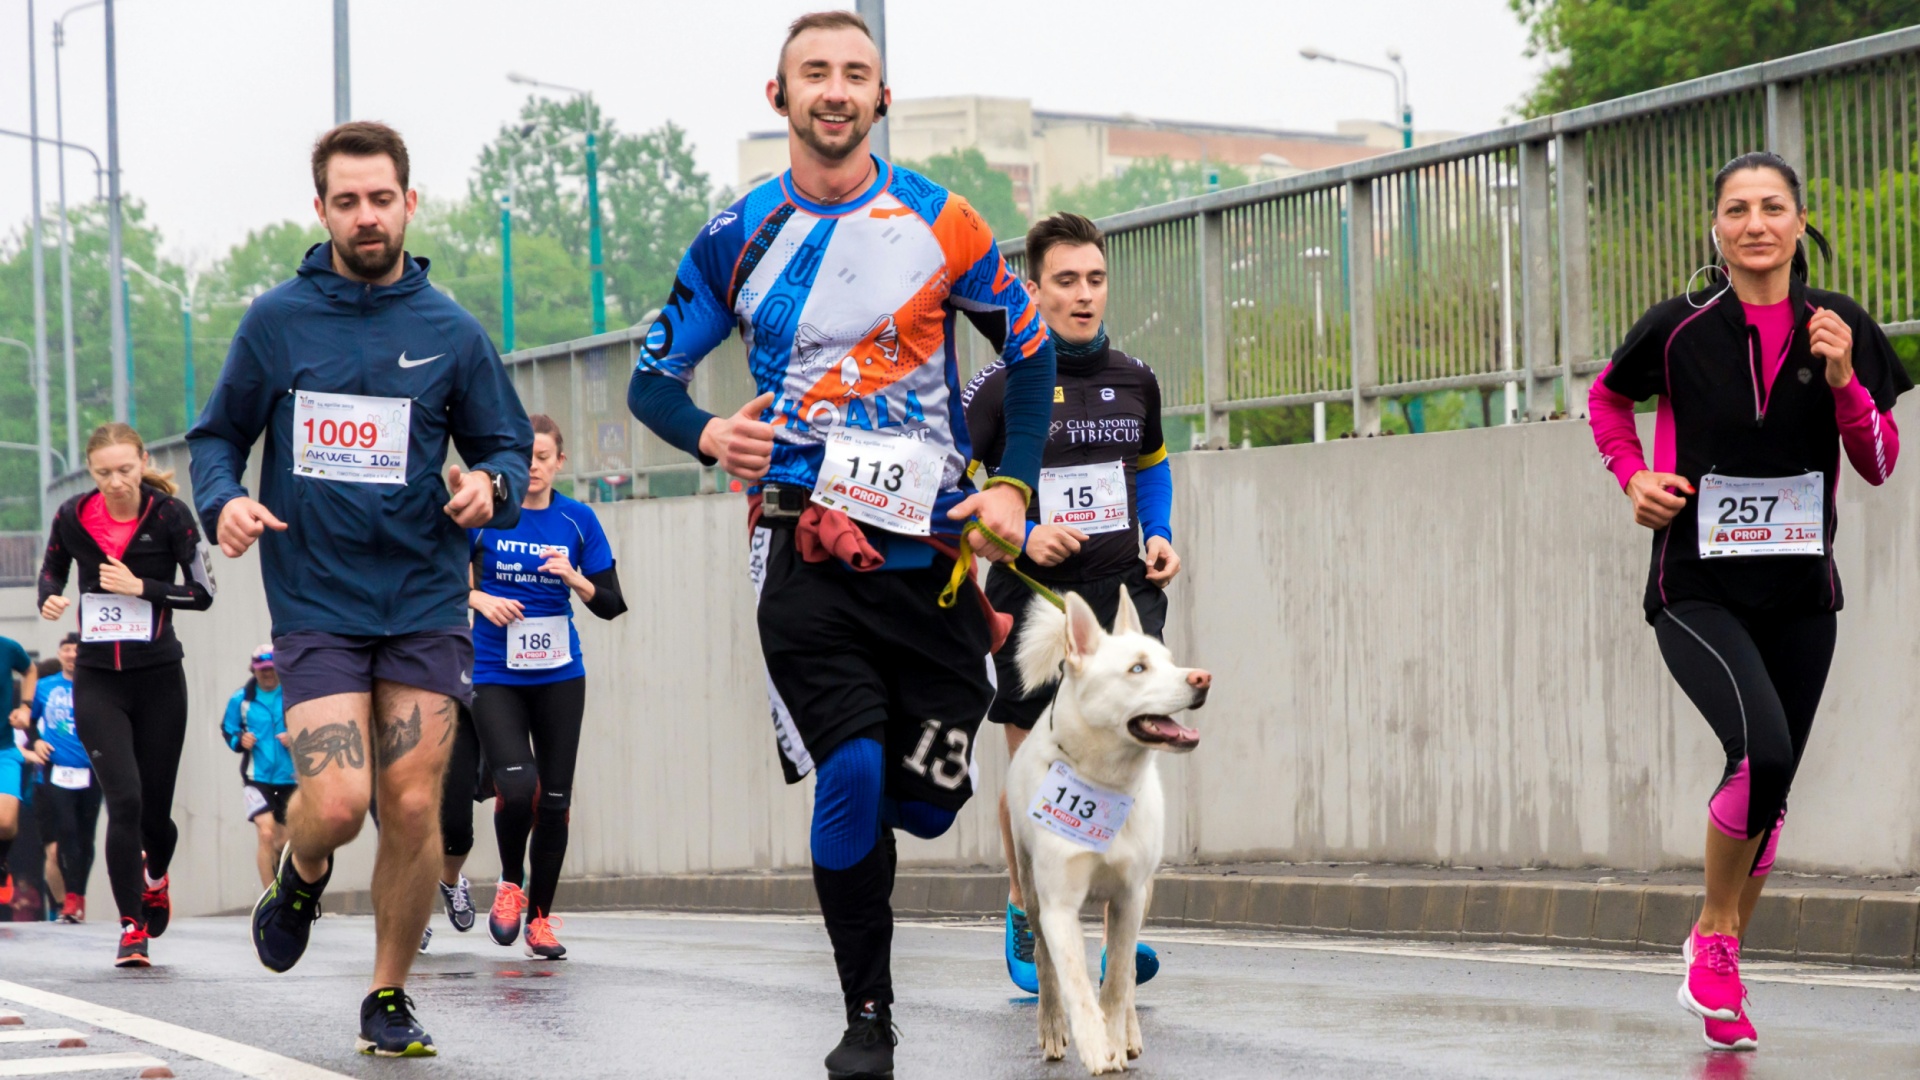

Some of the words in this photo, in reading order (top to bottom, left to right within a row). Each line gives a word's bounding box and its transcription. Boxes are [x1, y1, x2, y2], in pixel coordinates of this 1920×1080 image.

[1066, 419, 1096, 430] CLUB
[1099, 418, 1139, 429] SPORTIV
[303, 418, 378, 449] 1009
[1066, 428, 1140, 444] TIBISCUS
[306, 449, 362, 464] AKWEL
[846, 456, 905, 492] 113
[851, 488, 887, 507] PROFI
[1063, 486, 1094, 509] 15
[1068, 511, 1094, 522] PROFI
[1718, 495, 1779, 525] 257
[1734, 529, 1769, 541] PROFI
[496, 539, 529, 555] NTT
[496, 560, 523, 572] Run@
[496, 571, 512, 582] NTT
[514, 573, 537, 583] DATA
[540, 575, 561, 585] Team
[99, 606, 122, 622] 33
[518, 632, 551, 650] 186
[901, 718, 969, 791] 13
[1055, 786, 1097, 819] 113
